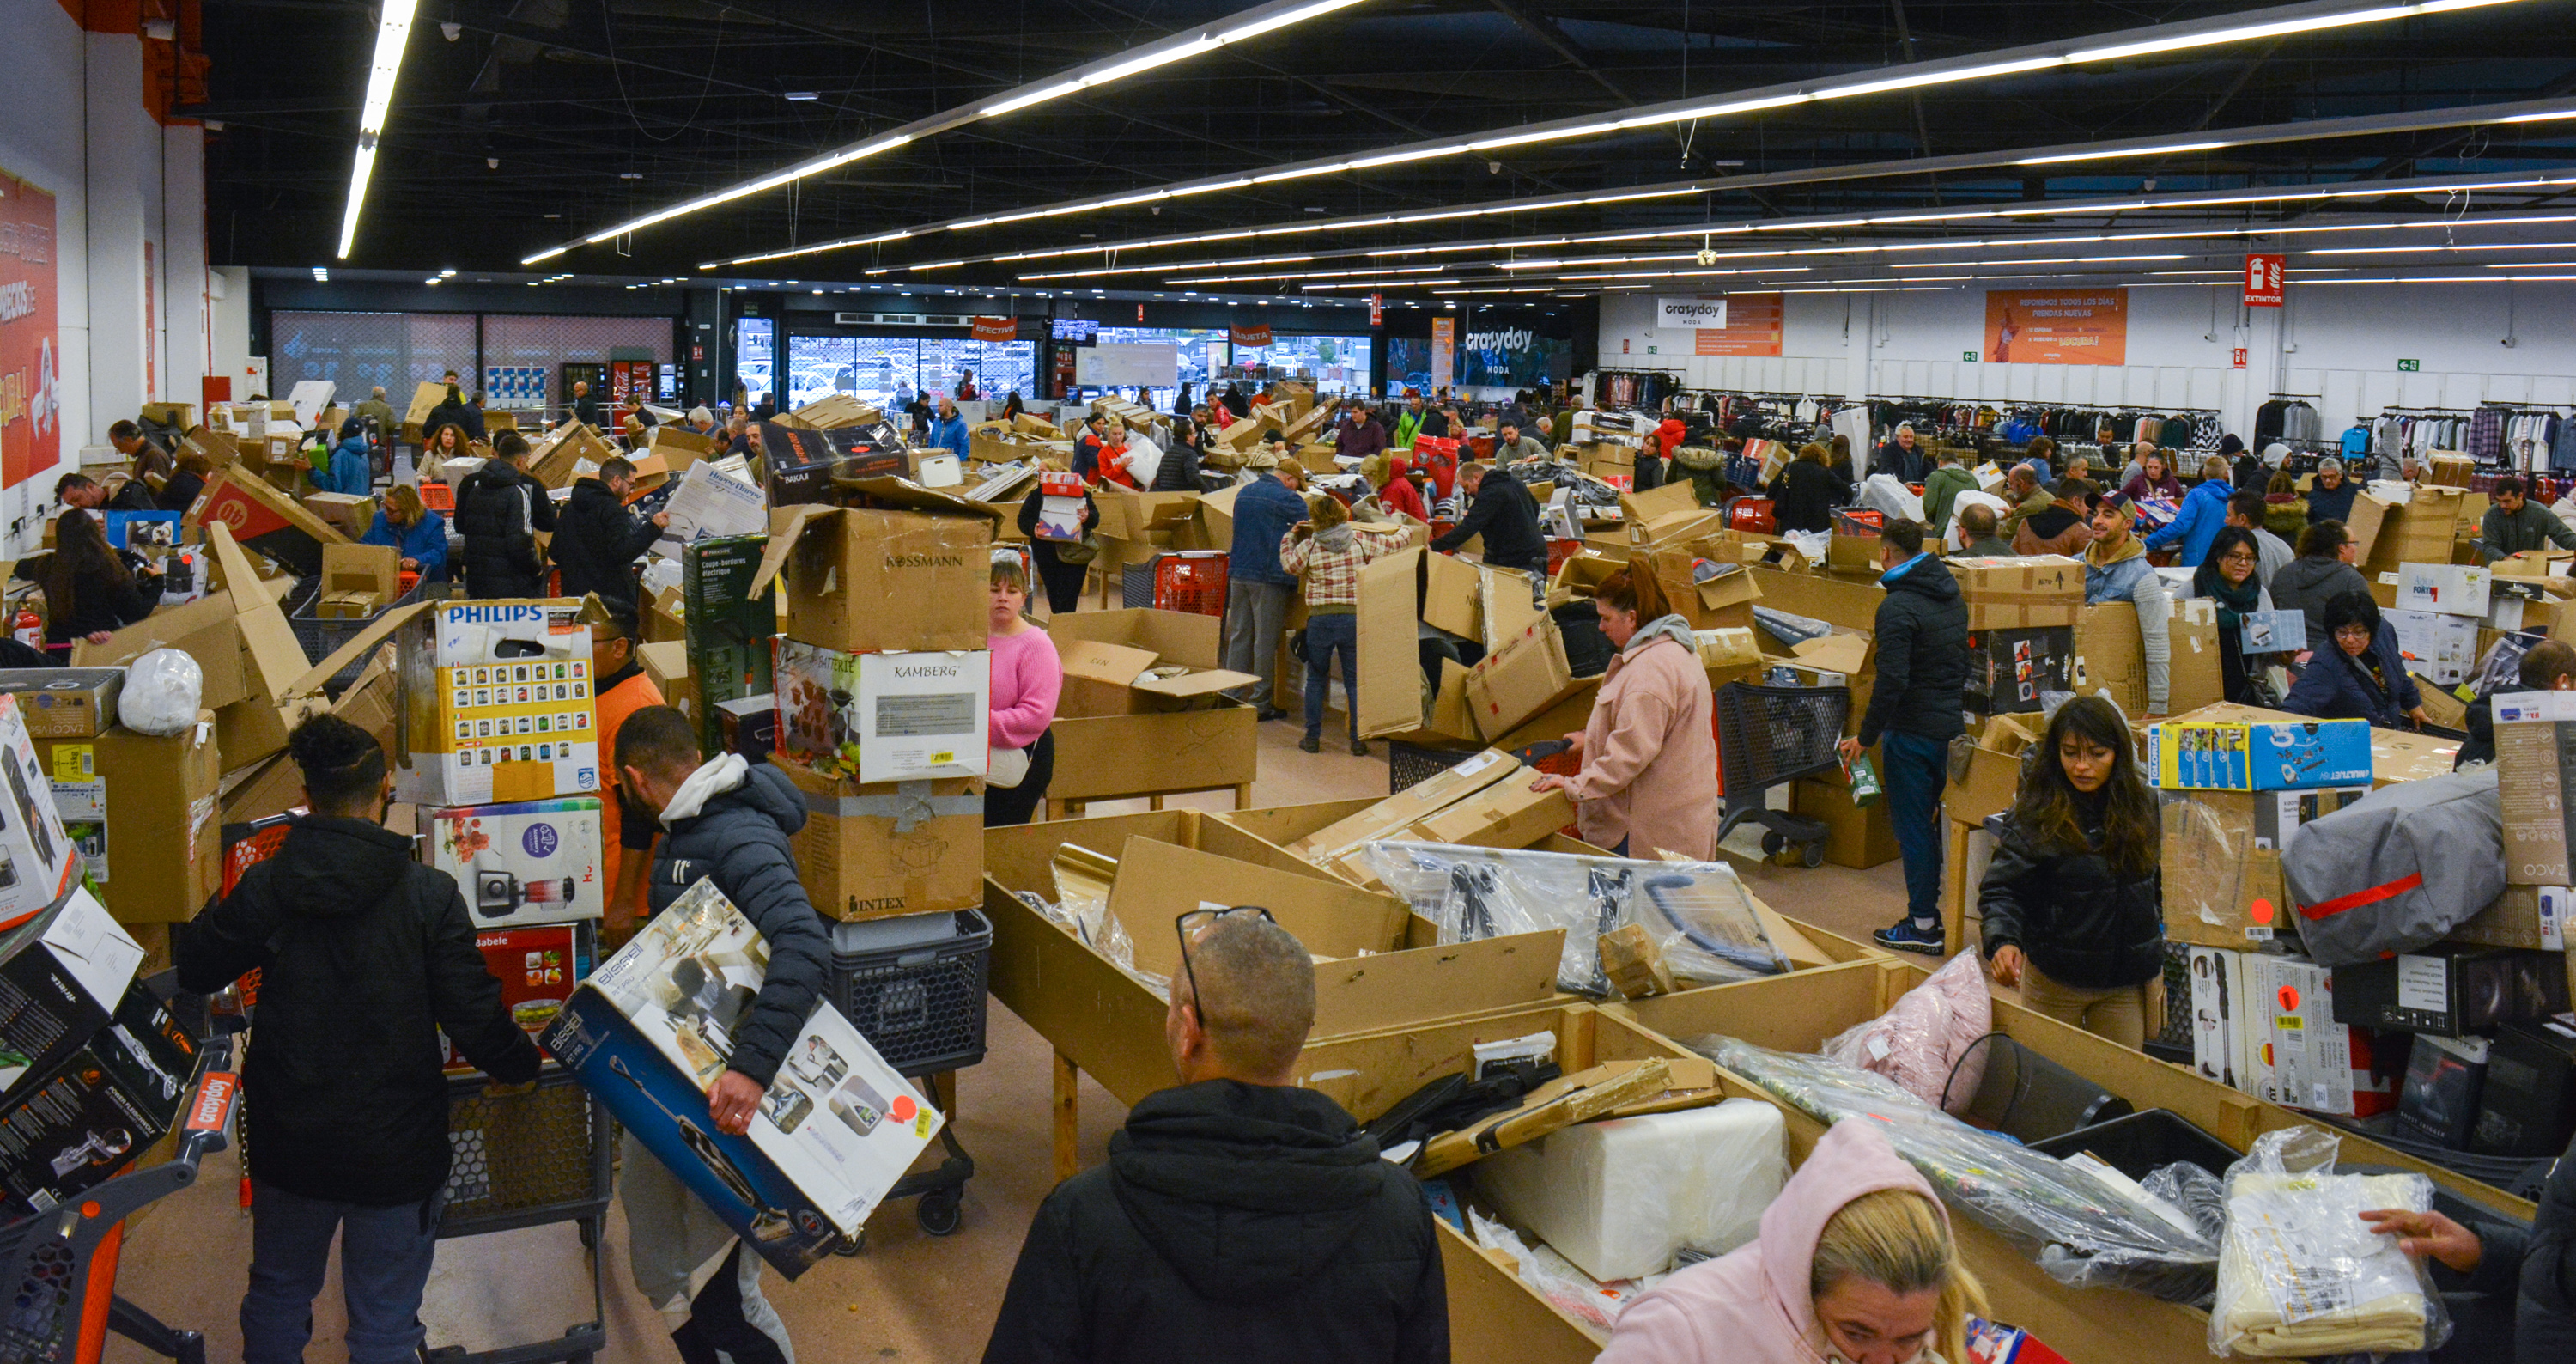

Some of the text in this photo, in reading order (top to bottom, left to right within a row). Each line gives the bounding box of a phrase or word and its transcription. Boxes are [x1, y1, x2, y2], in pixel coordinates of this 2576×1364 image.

[0, 280, 27, 320] RECIOS
[2020, 298, 2057, 307] REPONEMOS
[2099, 295, 2115, 305] DÍAS
[2245, 295, 2281, 303] EXTINTOR
[1665, 303, 1720, 318] crazyday
[975, 324, 1014, 335] EFECTIVO
[1233, 331, 1268, 341] TARJETA
[1466, 326, 1533, 355] crazyday
[2059, 336, 2099, 346] LOCURA!
[1486, 366, 1510, 374] MODA
[785, 472, 809, 484] BAKAJI
[702, 557, 746, 569] Coupe-bordures
[886, 556, 962, 567] ROSSMANN
[702, 568, 731, 577] électrique
[449, 605, 543, 624] PHILIPS
[818, 655, 854, 673] BATTERIE
[895, 665, 957, 678] KAMBERG
[53, 724, 84, 734] ZACO
[2330, 770, 2366, 780] MULTIJET
[2524, 864, 2567, 877] ZACO
[860, 897, 906, 912] INTEX
[198, 1079, 231, 1123] crazyday
[108, 1086, 126, 1104] POWER
[125, 1102, 155, 1135] FLEISCHWOLF
